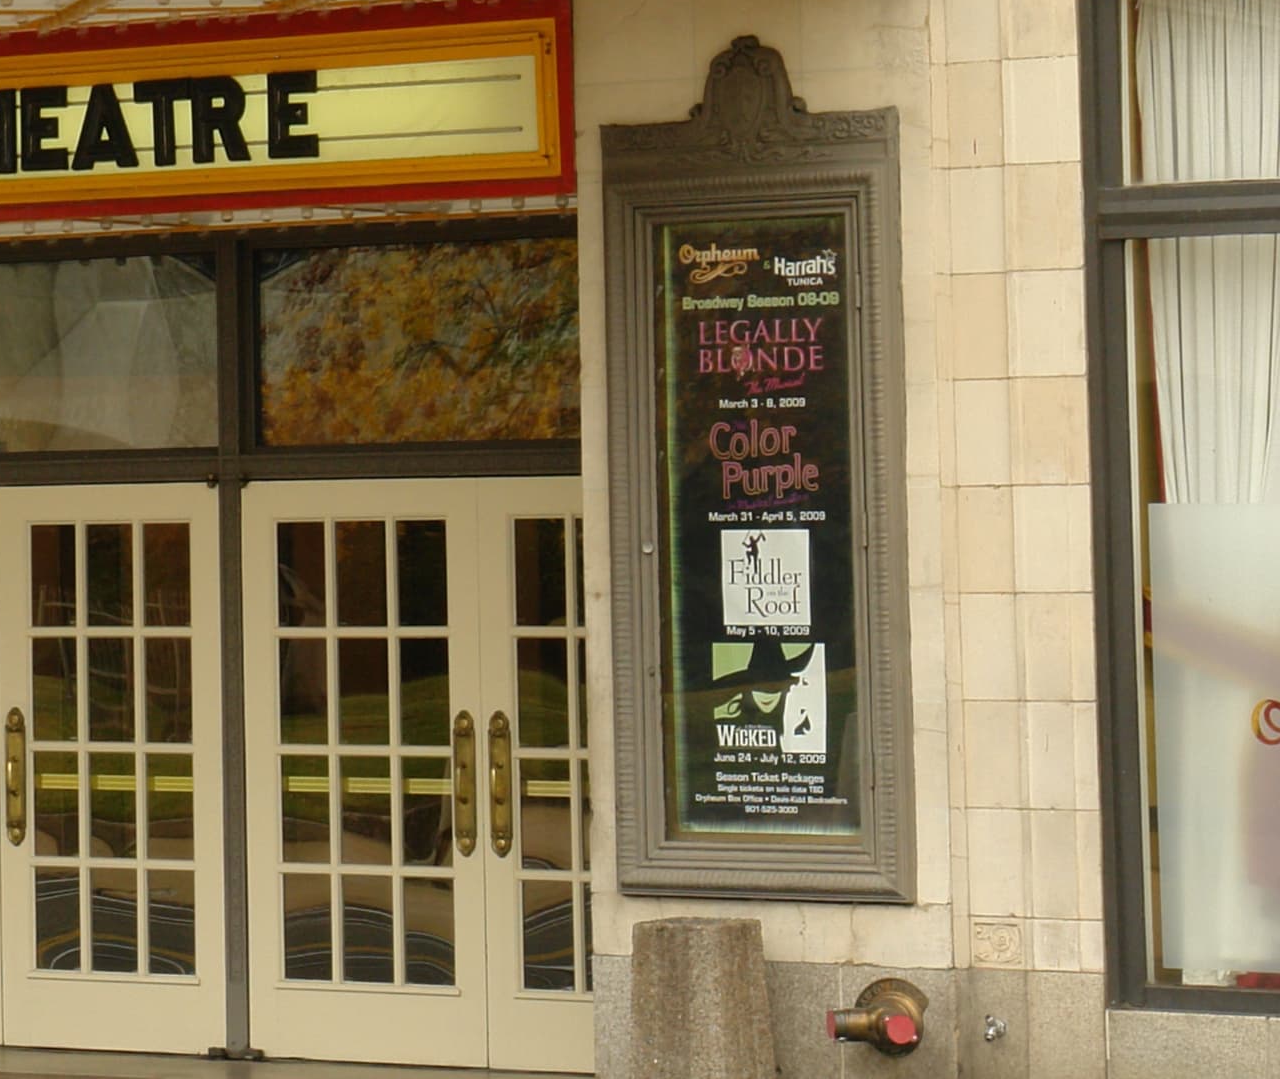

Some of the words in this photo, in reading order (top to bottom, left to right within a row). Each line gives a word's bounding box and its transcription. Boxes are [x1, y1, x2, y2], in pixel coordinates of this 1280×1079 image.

[679, 243, 760, 268] Orpheum
[787, 277, 823, 286] TUNICA
[682, 296, 744, 311] Broadway
[747, 294, 794, 308] Season
[699, 318, 823, 345] LEGALLY
[699, 346, 825, 373] BLONDE
[719, 399, 748, 408] March
[779, 397, 806, 407] 2009
[709, 419, 797, 460] Color
[722, 452, 819, 499] Purple
[708, 511, 738, 522] March
[740, 511, 753, 521] 31
[761, 511, 784, 523] April
[799, 511, 826, 521] 2009
[728, 558, 802, 585] Fiddler
[745, 584, 802, 618] Roof
[726, 626, 746, 638] May
[748, 626, 755, 635] 5
[783, 626, 810, 635] 2009
[714, 753, 735, 762] June
[738, 752, 751, 762] 24
[760, 753, 778, 765] July
[799, 754, 826, 764] 2009
[715, 772, 749, 782] Season
[751, 772, 779, 782] Ticket
[782, 772, 824, 785] Packages
